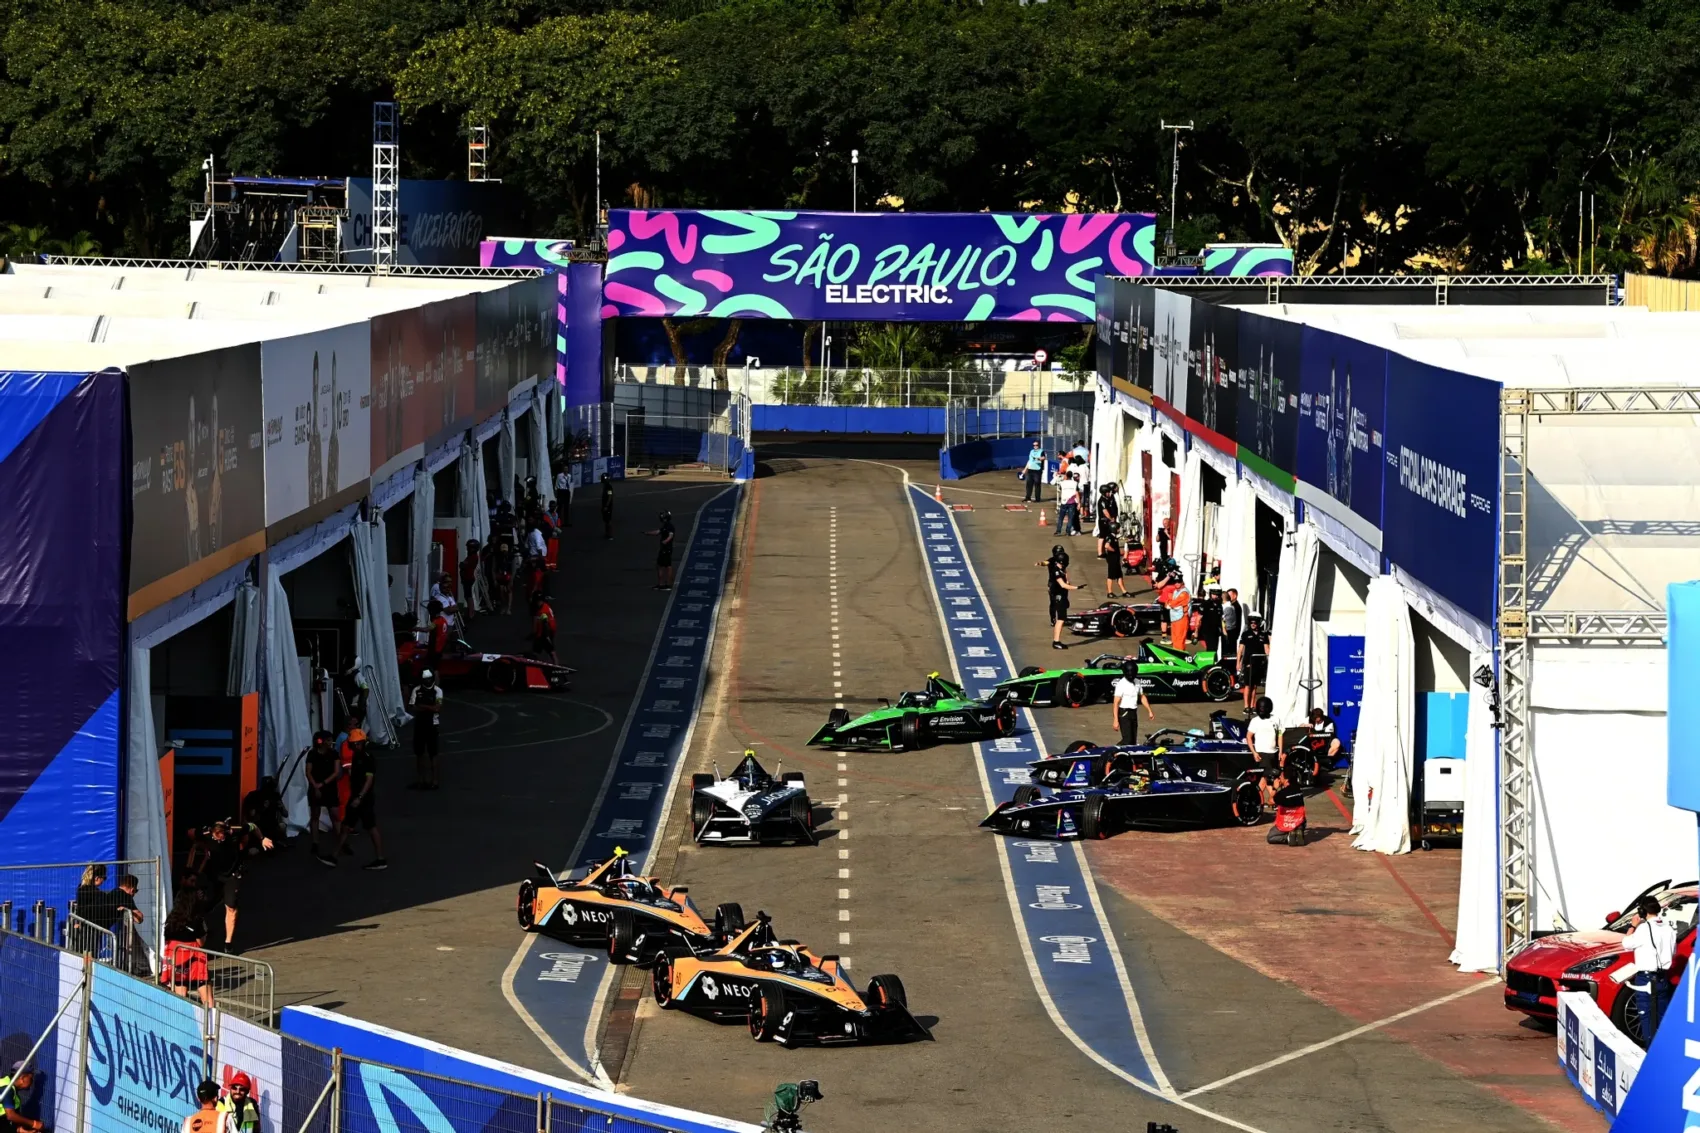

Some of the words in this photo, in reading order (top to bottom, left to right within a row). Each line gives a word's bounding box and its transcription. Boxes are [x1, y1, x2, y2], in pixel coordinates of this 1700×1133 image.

[354, 213, 408, 246] CHE
[411, 210, 483, 251] ACCELERATED
[763, 233, 860, 288] SÃO
[825, 284, 953, 304] ELECTRIC.
[1421, 455, 1437, 504] CARS
[1437, 463, 1466, 519] GARAGE
[1172, 677, 1200, 688] Algorand
[939, 715, 964, 723] Envision
